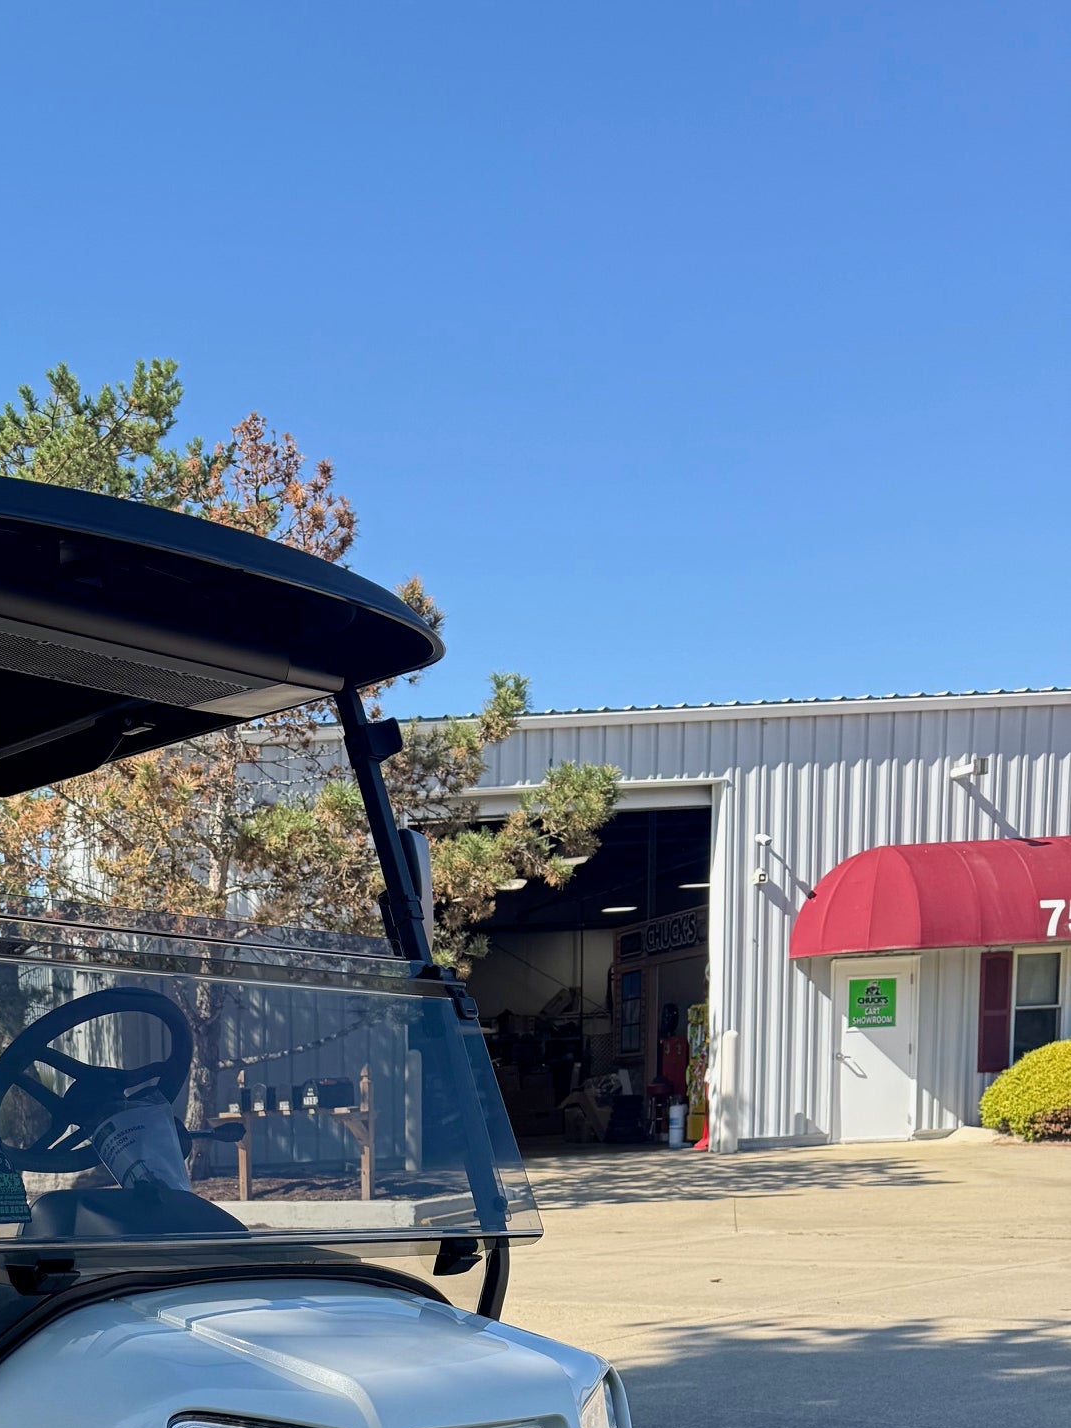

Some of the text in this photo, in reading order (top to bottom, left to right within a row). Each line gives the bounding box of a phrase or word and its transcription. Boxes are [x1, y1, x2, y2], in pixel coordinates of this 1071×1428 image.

[1039, 899, 1071, 937] 7
[646, 912, 697, 953] CHUCK'S
[852, 1016, 893, 1025] SHOWROOM
[865, 1007, 881, 1015] CART
